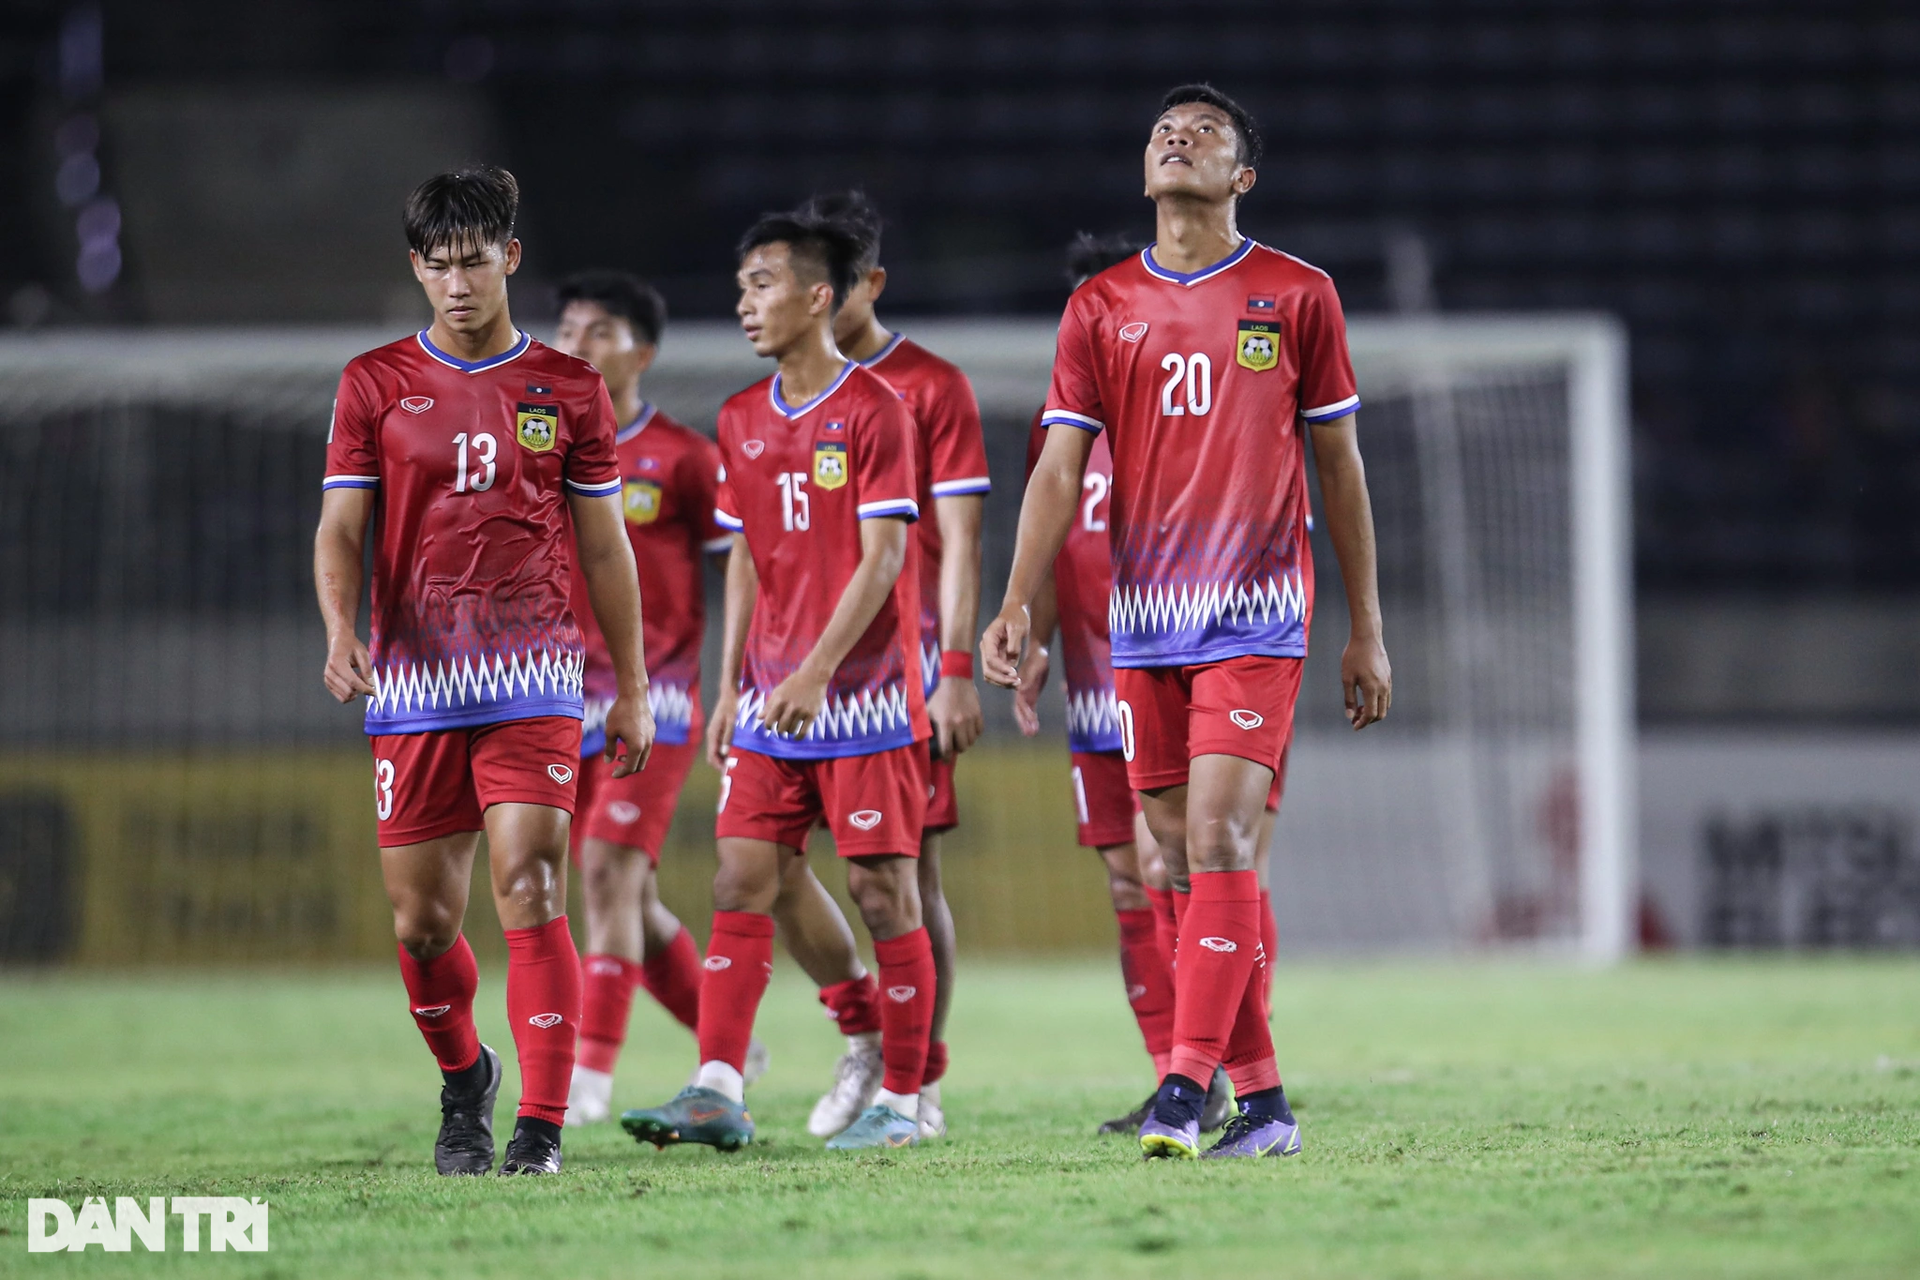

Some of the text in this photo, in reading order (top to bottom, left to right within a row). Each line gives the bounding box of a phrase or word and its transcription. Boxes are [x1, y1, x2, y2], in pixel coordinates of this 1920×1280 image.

[1161, 352, 1211, 416] 20
[452, 432, 497, 492] 13
[776, 472, 810, 531] 15
[1083, 472, 1113, 532] 2
